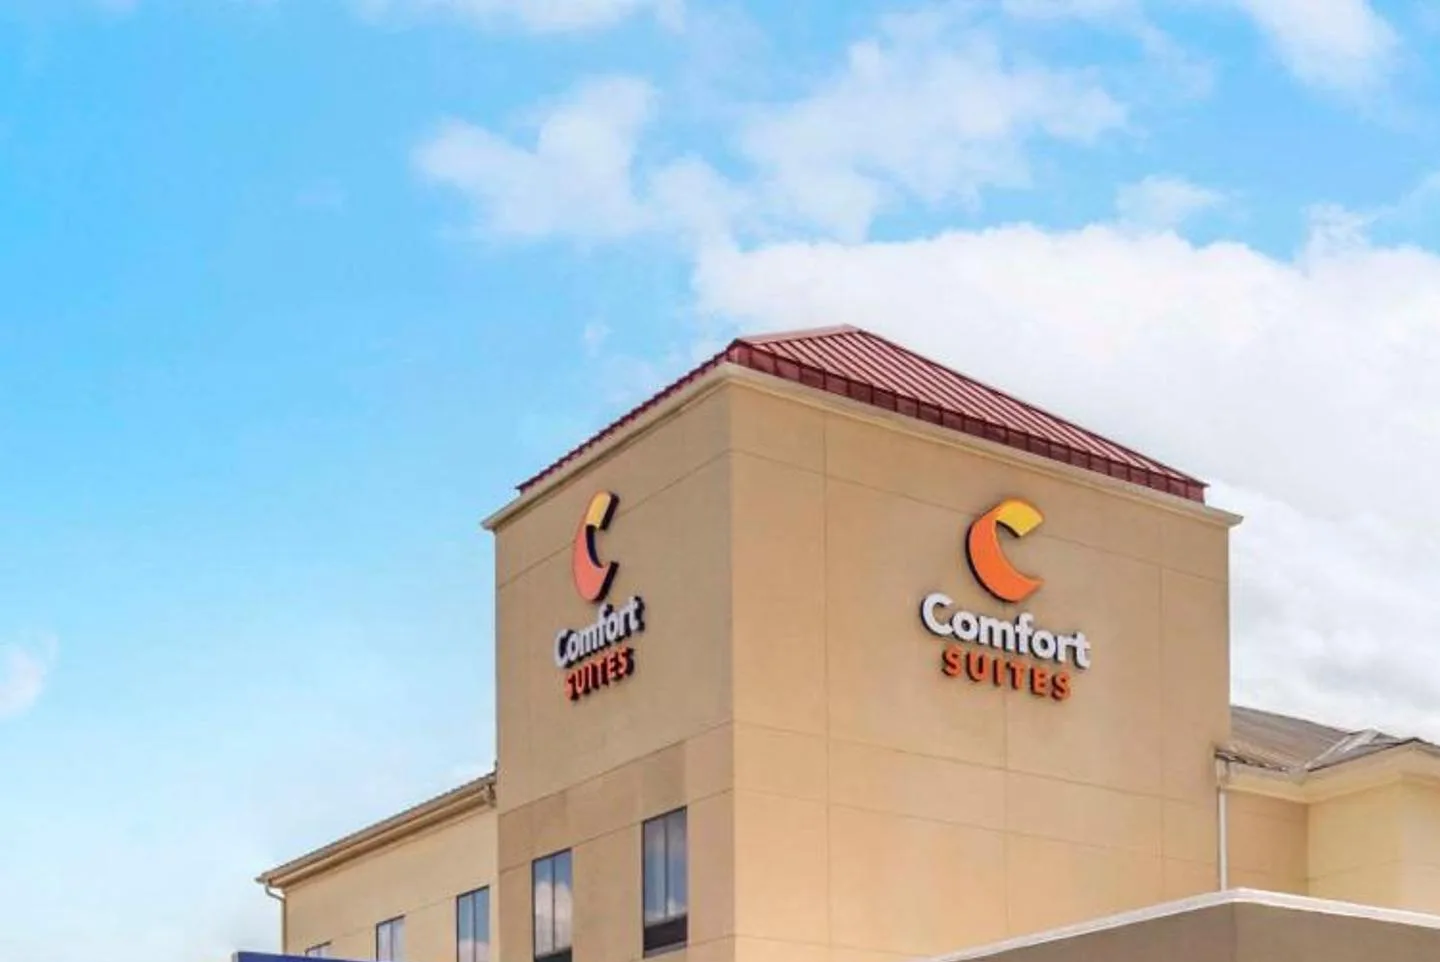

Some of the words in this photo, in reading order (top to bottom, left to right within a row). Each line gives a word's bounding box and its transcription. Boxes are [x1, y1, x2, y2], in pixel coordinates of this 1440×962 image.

[555, 596, 643, 668] Comfort
[921, 593, 1091, 668] Comfort
[566, 645, 634, 701] SUITES
[943, 645, 1071, 700] SUITES
